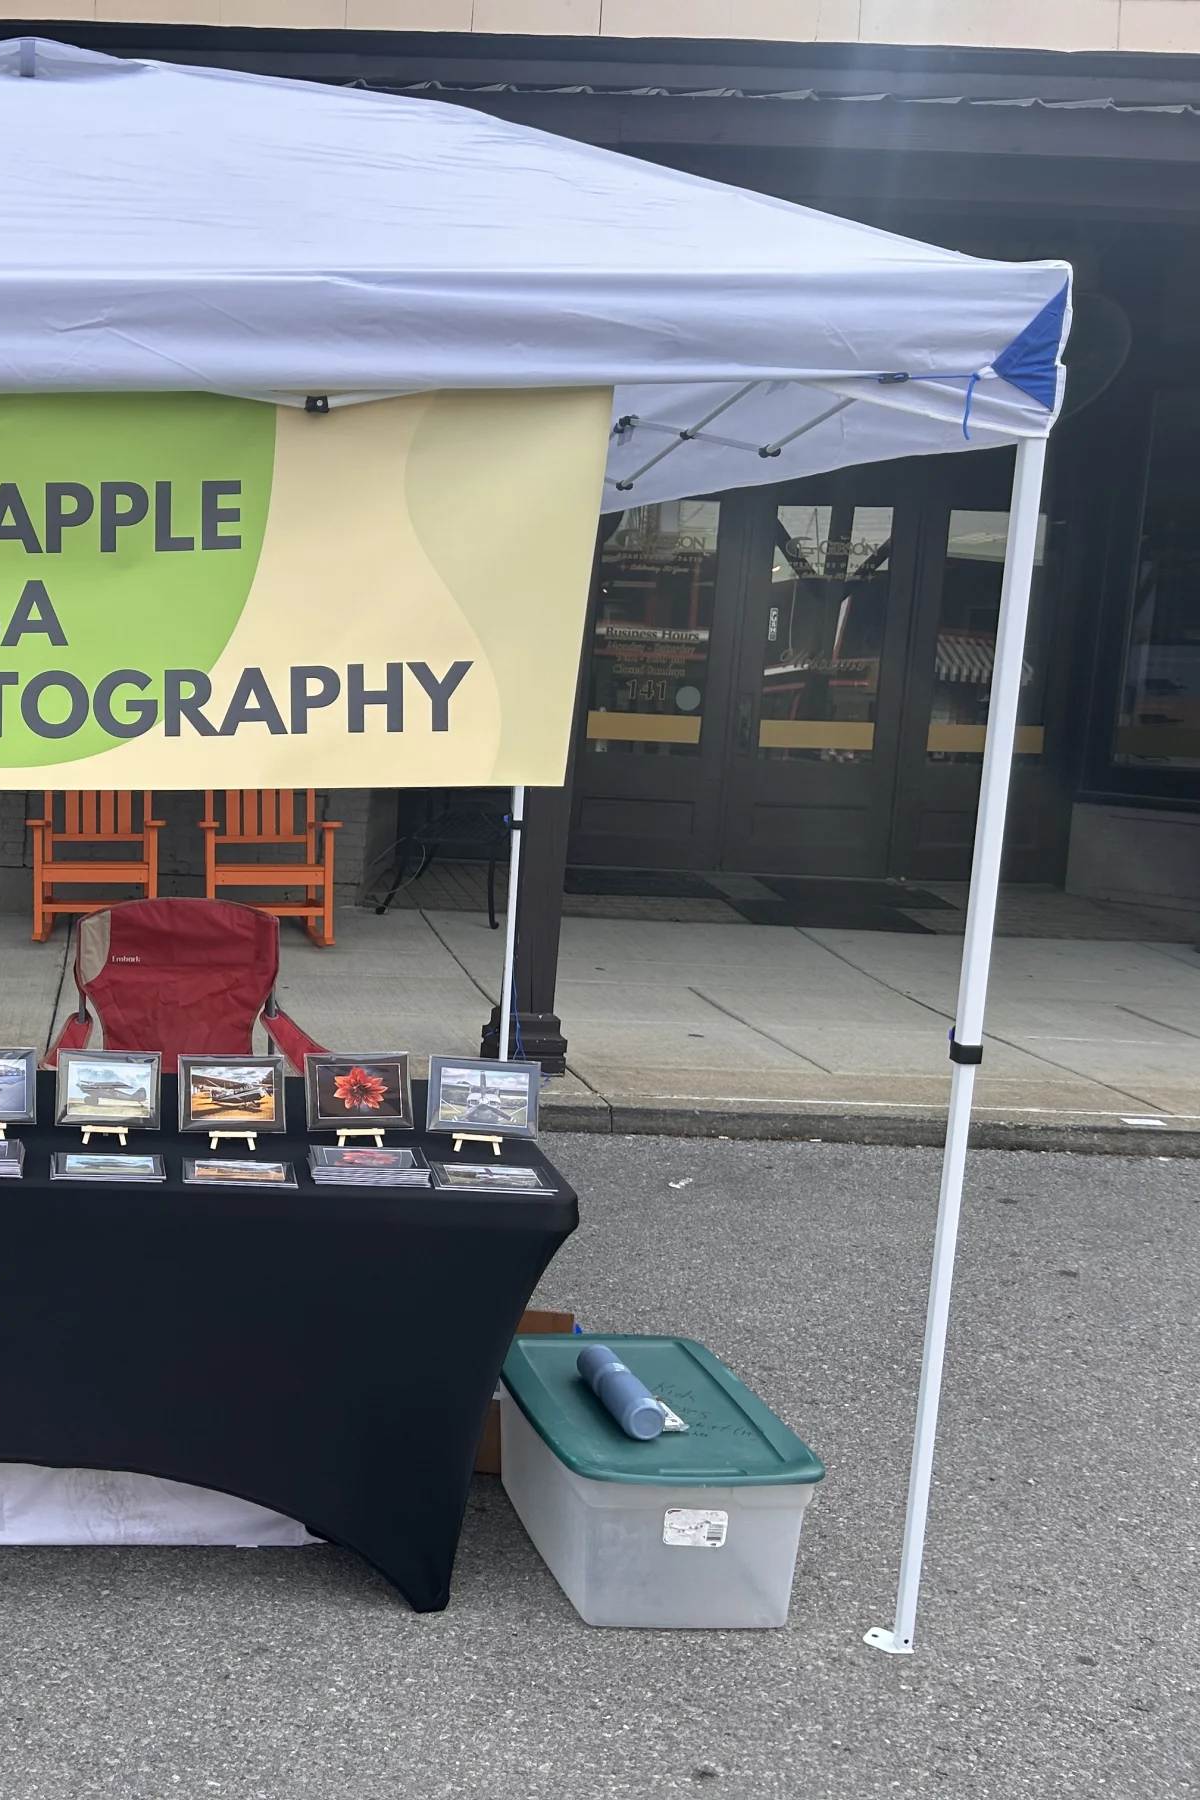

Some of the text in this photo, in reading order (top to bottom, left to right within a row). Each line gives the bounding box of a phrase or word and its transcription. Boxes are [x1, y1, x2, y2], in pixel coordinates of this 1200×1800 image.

[606, 626, 700, 641] Business Hours
[626, 679, 667, 700] 141
[112, 955, 141, 963] Embark
